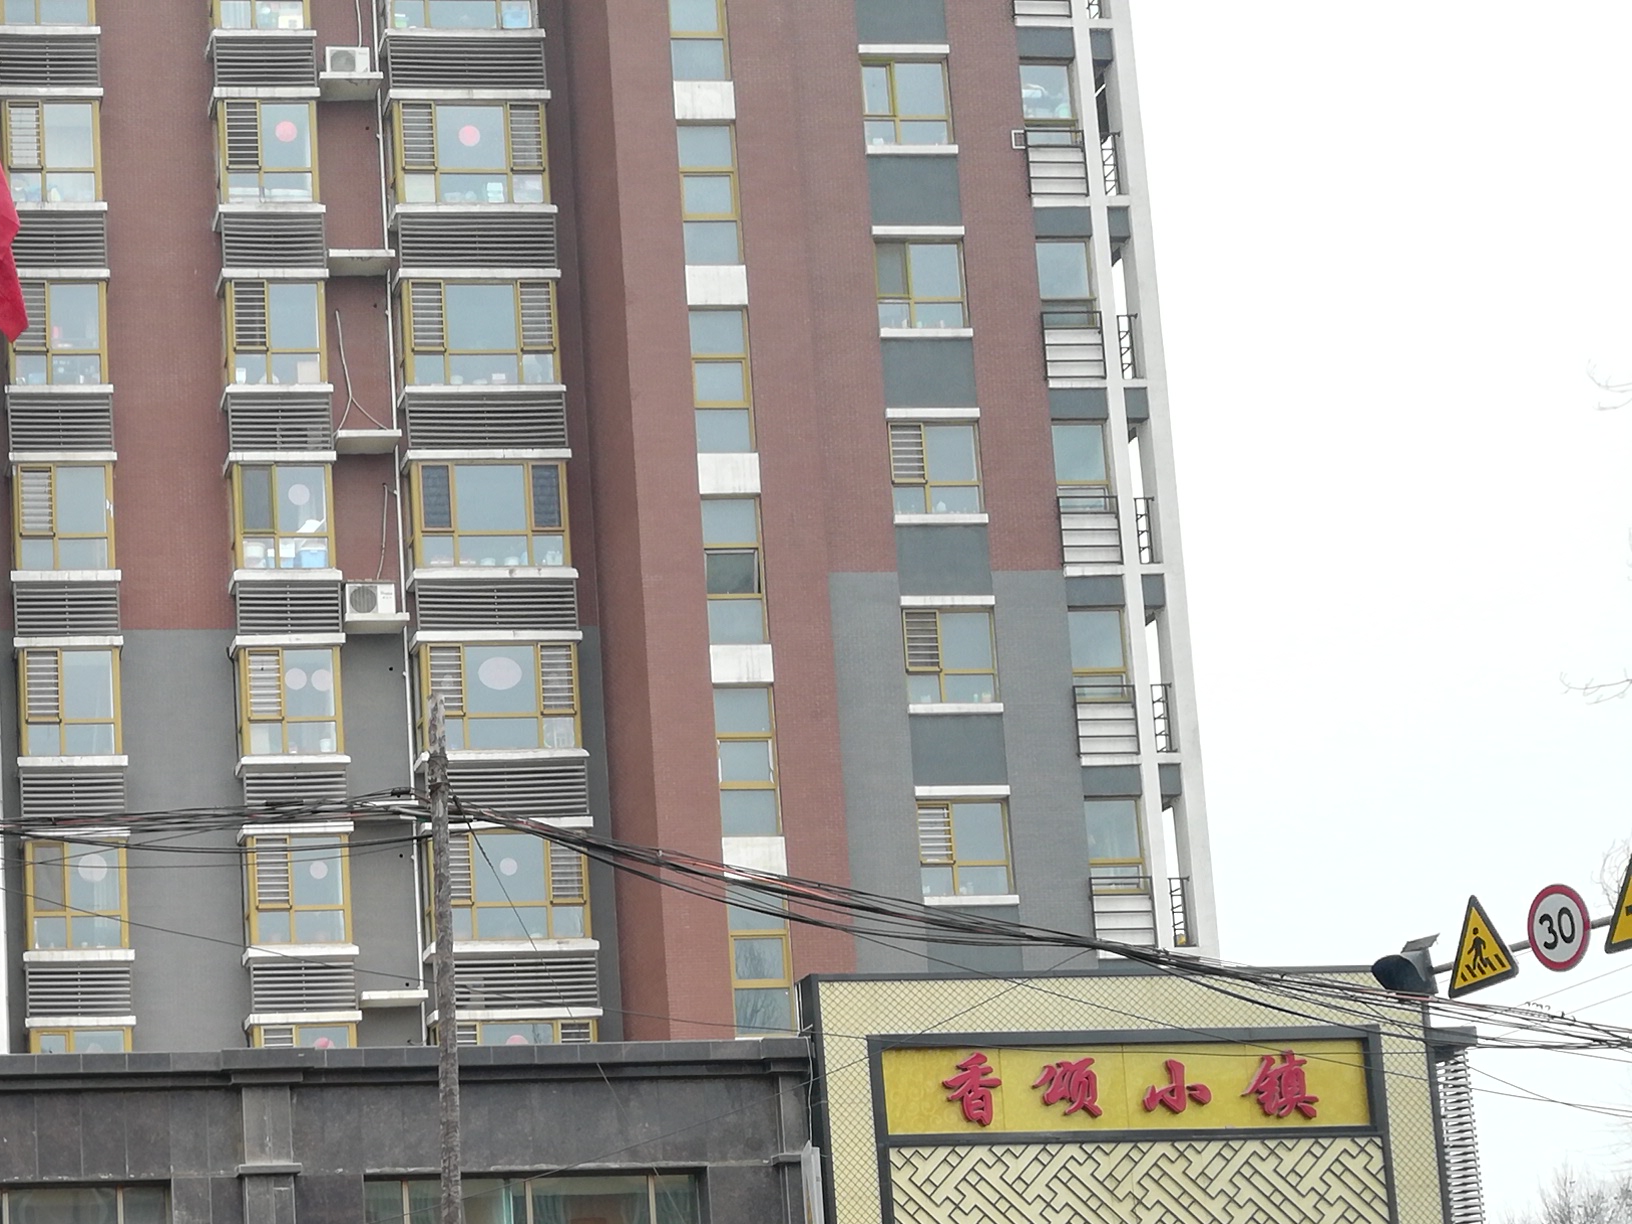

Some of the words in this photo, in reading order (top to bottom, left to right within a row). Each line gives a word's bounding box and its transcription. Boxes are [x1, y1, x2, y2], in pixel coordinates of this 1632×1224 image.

[1538, 906, 1576, 951] 30
[941, 1049, 1320, 1127] 香颂小镇
